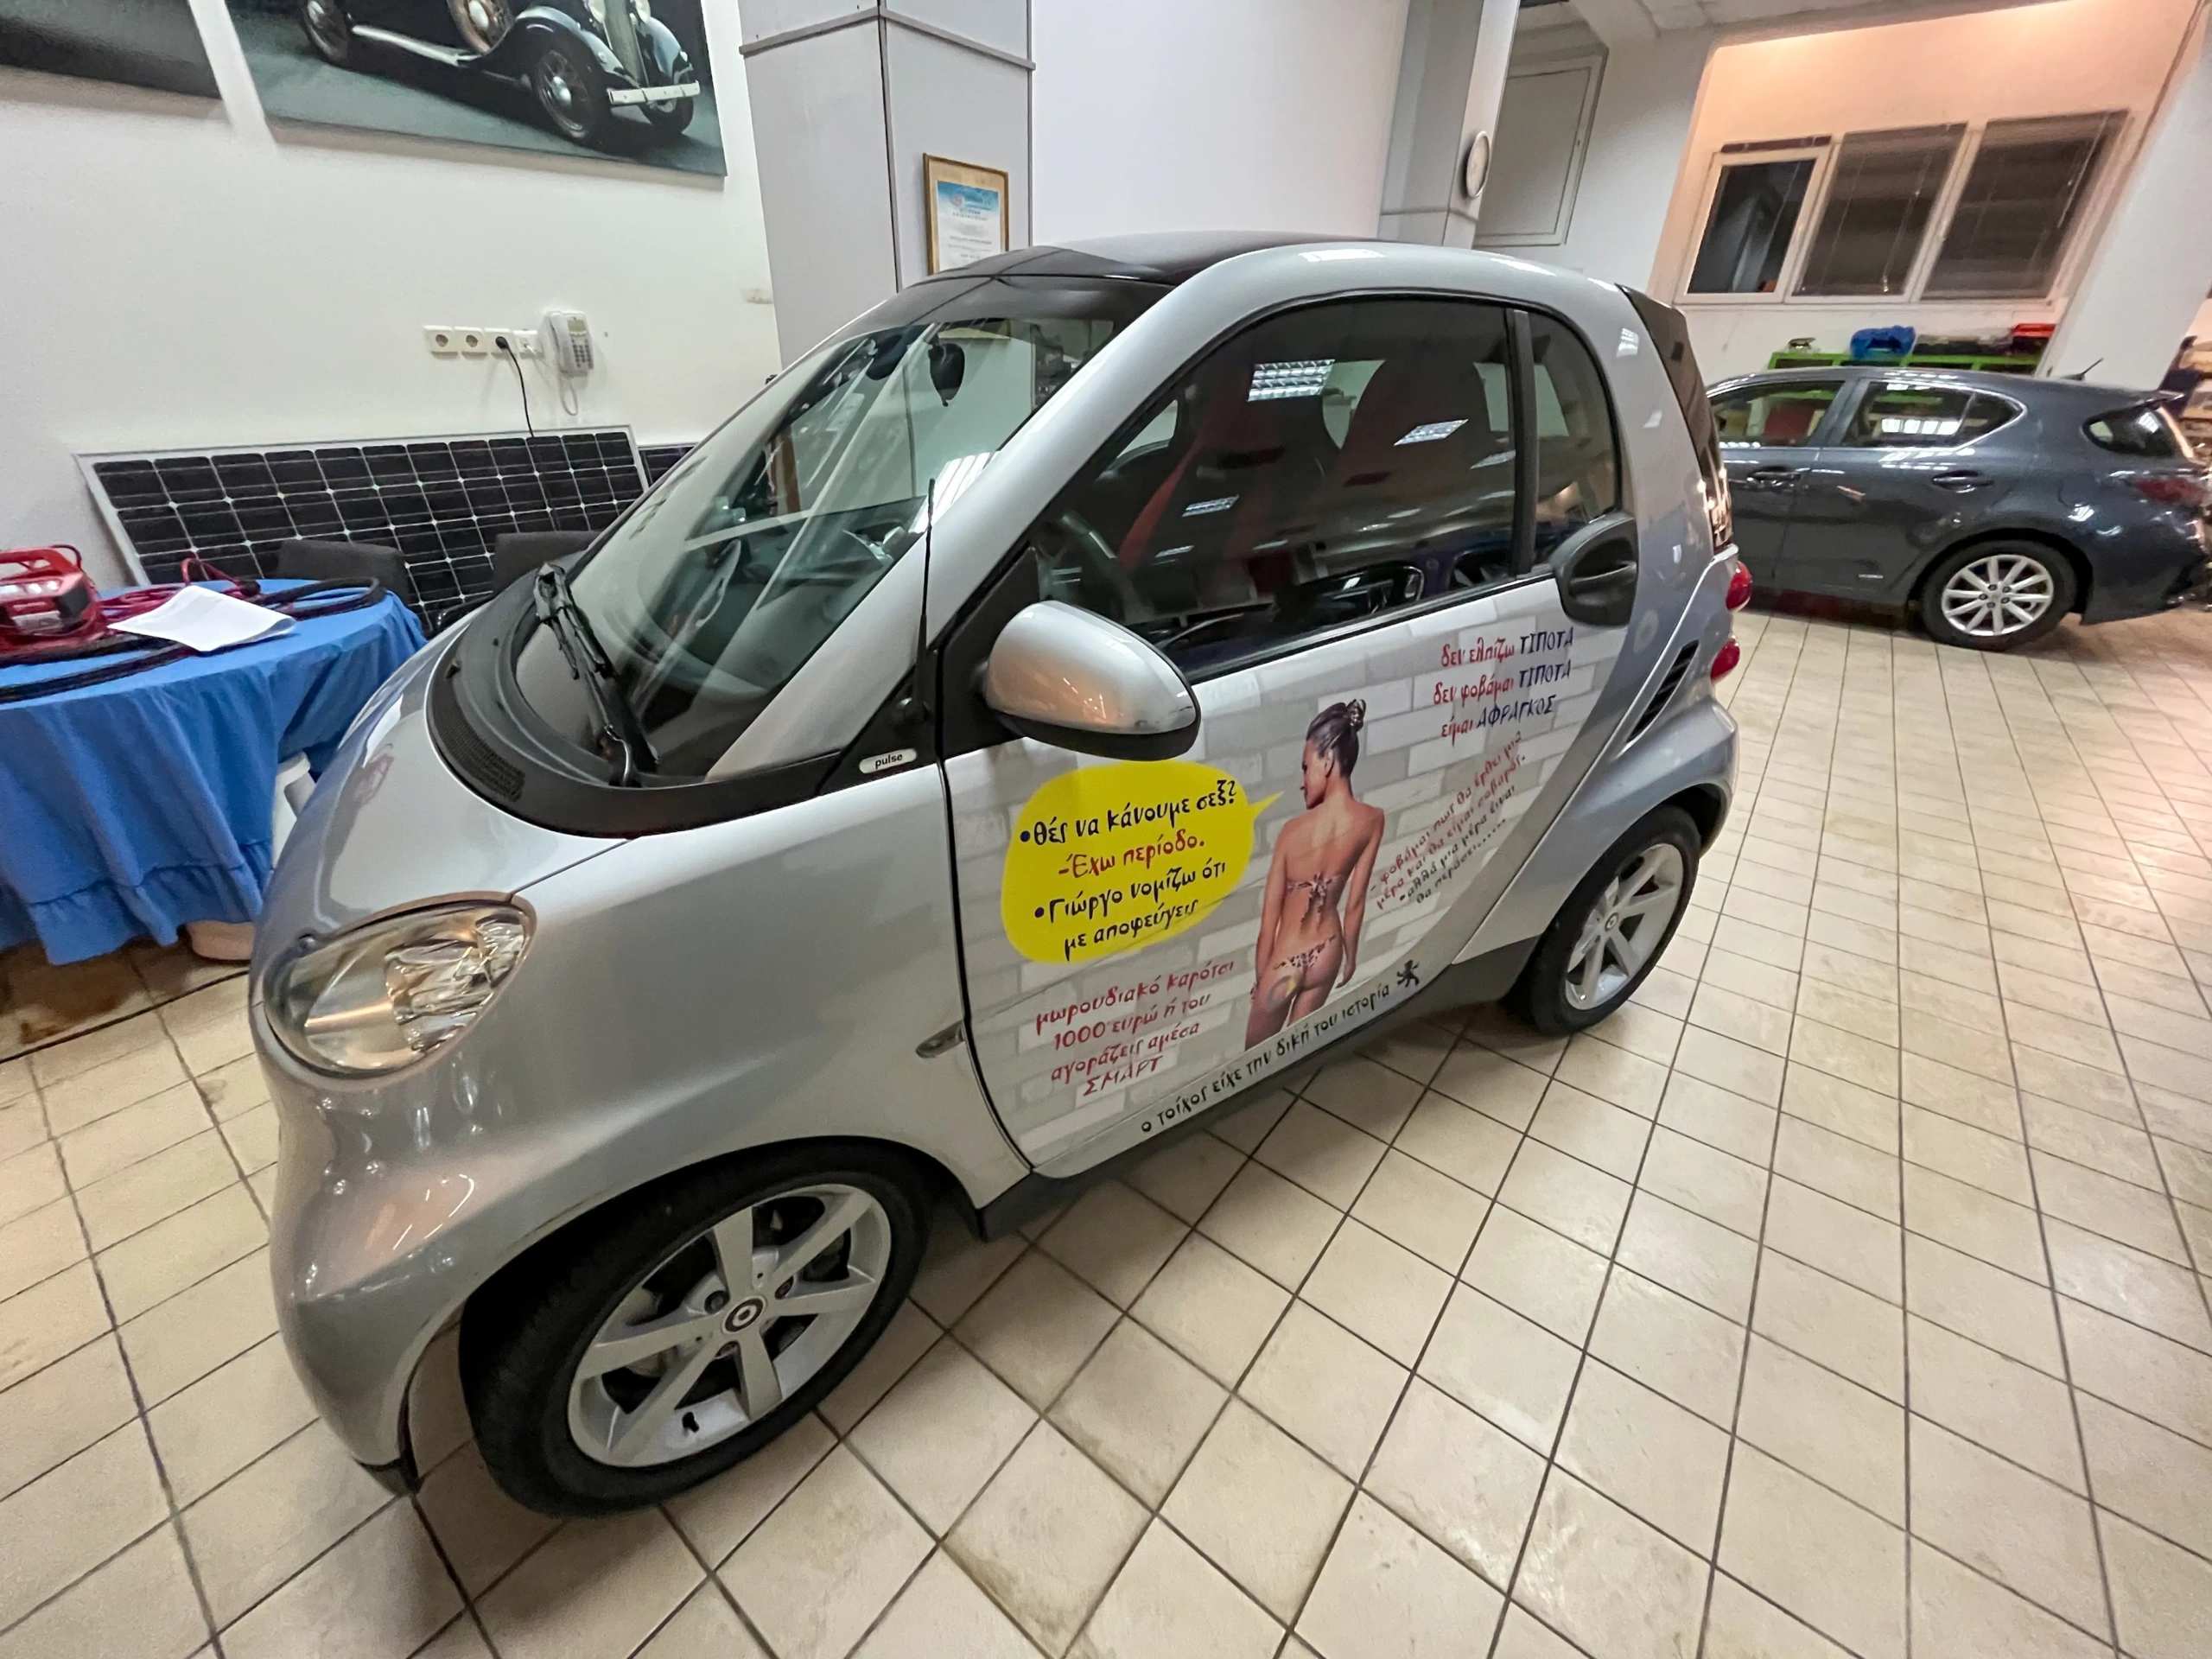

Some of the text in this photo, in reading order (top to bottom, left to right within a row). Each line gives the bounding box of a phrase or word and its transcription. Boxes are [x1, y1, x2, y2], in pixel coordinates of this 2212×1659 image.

[1441, 626, 1573, 668] δεν ελπίζω ΤΙΠΟΤΑ
[1433, 659, 1571, 708] δεν φοβάμαι ΤΙΠΟΤΑ
[1441, 694, 1557, 747] είμαι ΑΦΡΑΓΚΟΣ
[874, 753, 903, 769] pulse
[1076, 817, 1100, 838] να
[1107, 798, 1191, 832] κάνουμε
[1123, 829, 1205, 869] περίοδο.
[1049, 857, 1225, 924] Γιώργο νομίζω ότι
[1065, 899, 1198, 962] με αποφεύγεις
[1036, 961, 1234, 1036] μωρουδιακό καρότσι
[1054, 994, 1211, 1050] 1000 ευρώ ή του
[1051, 1022, 1200, 1084] αγοράζεις αμέσα
[1083, 1055, 1163, 1096] ΣΜΑΡΤ
[1157, 1086, 1208, 1123] τοίχος
[1212, 1066, 1242, 1094] είχε
[1245, 1050, 1272, 1076] την
[1276, 1023, 1309, 1056] δική
[1314, 1014, 1337, 1036] του
[1342, 984, 1390, 1020] ιστορία
